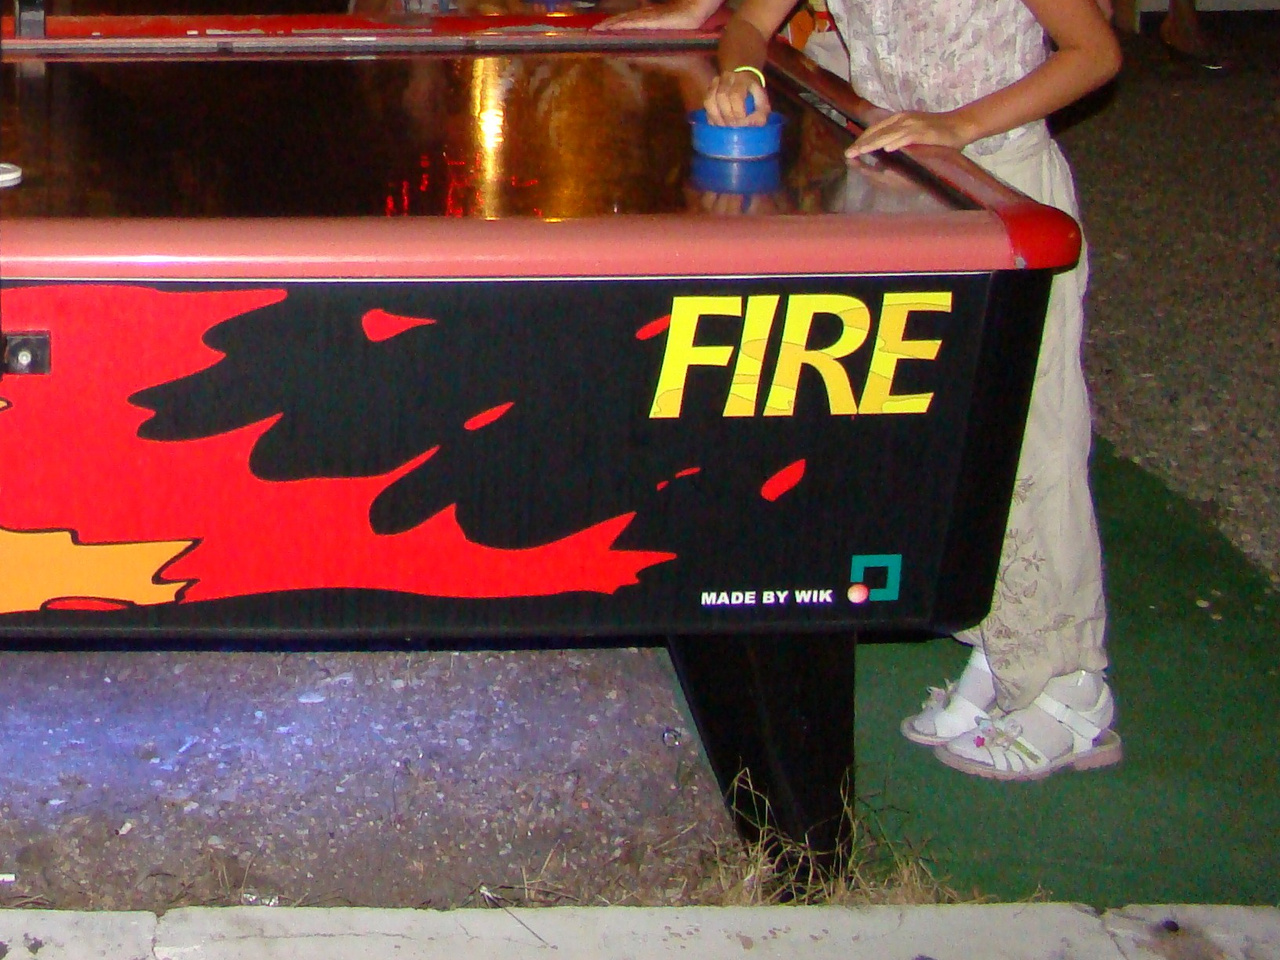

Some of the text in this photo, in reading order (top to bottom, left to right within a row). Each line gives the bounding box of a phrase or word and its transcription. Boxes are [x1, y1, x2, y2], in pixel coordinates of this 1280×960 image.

[649, 291, 952, 419] FIRE
[701, 589, 833, 605] MADE BY WIK
